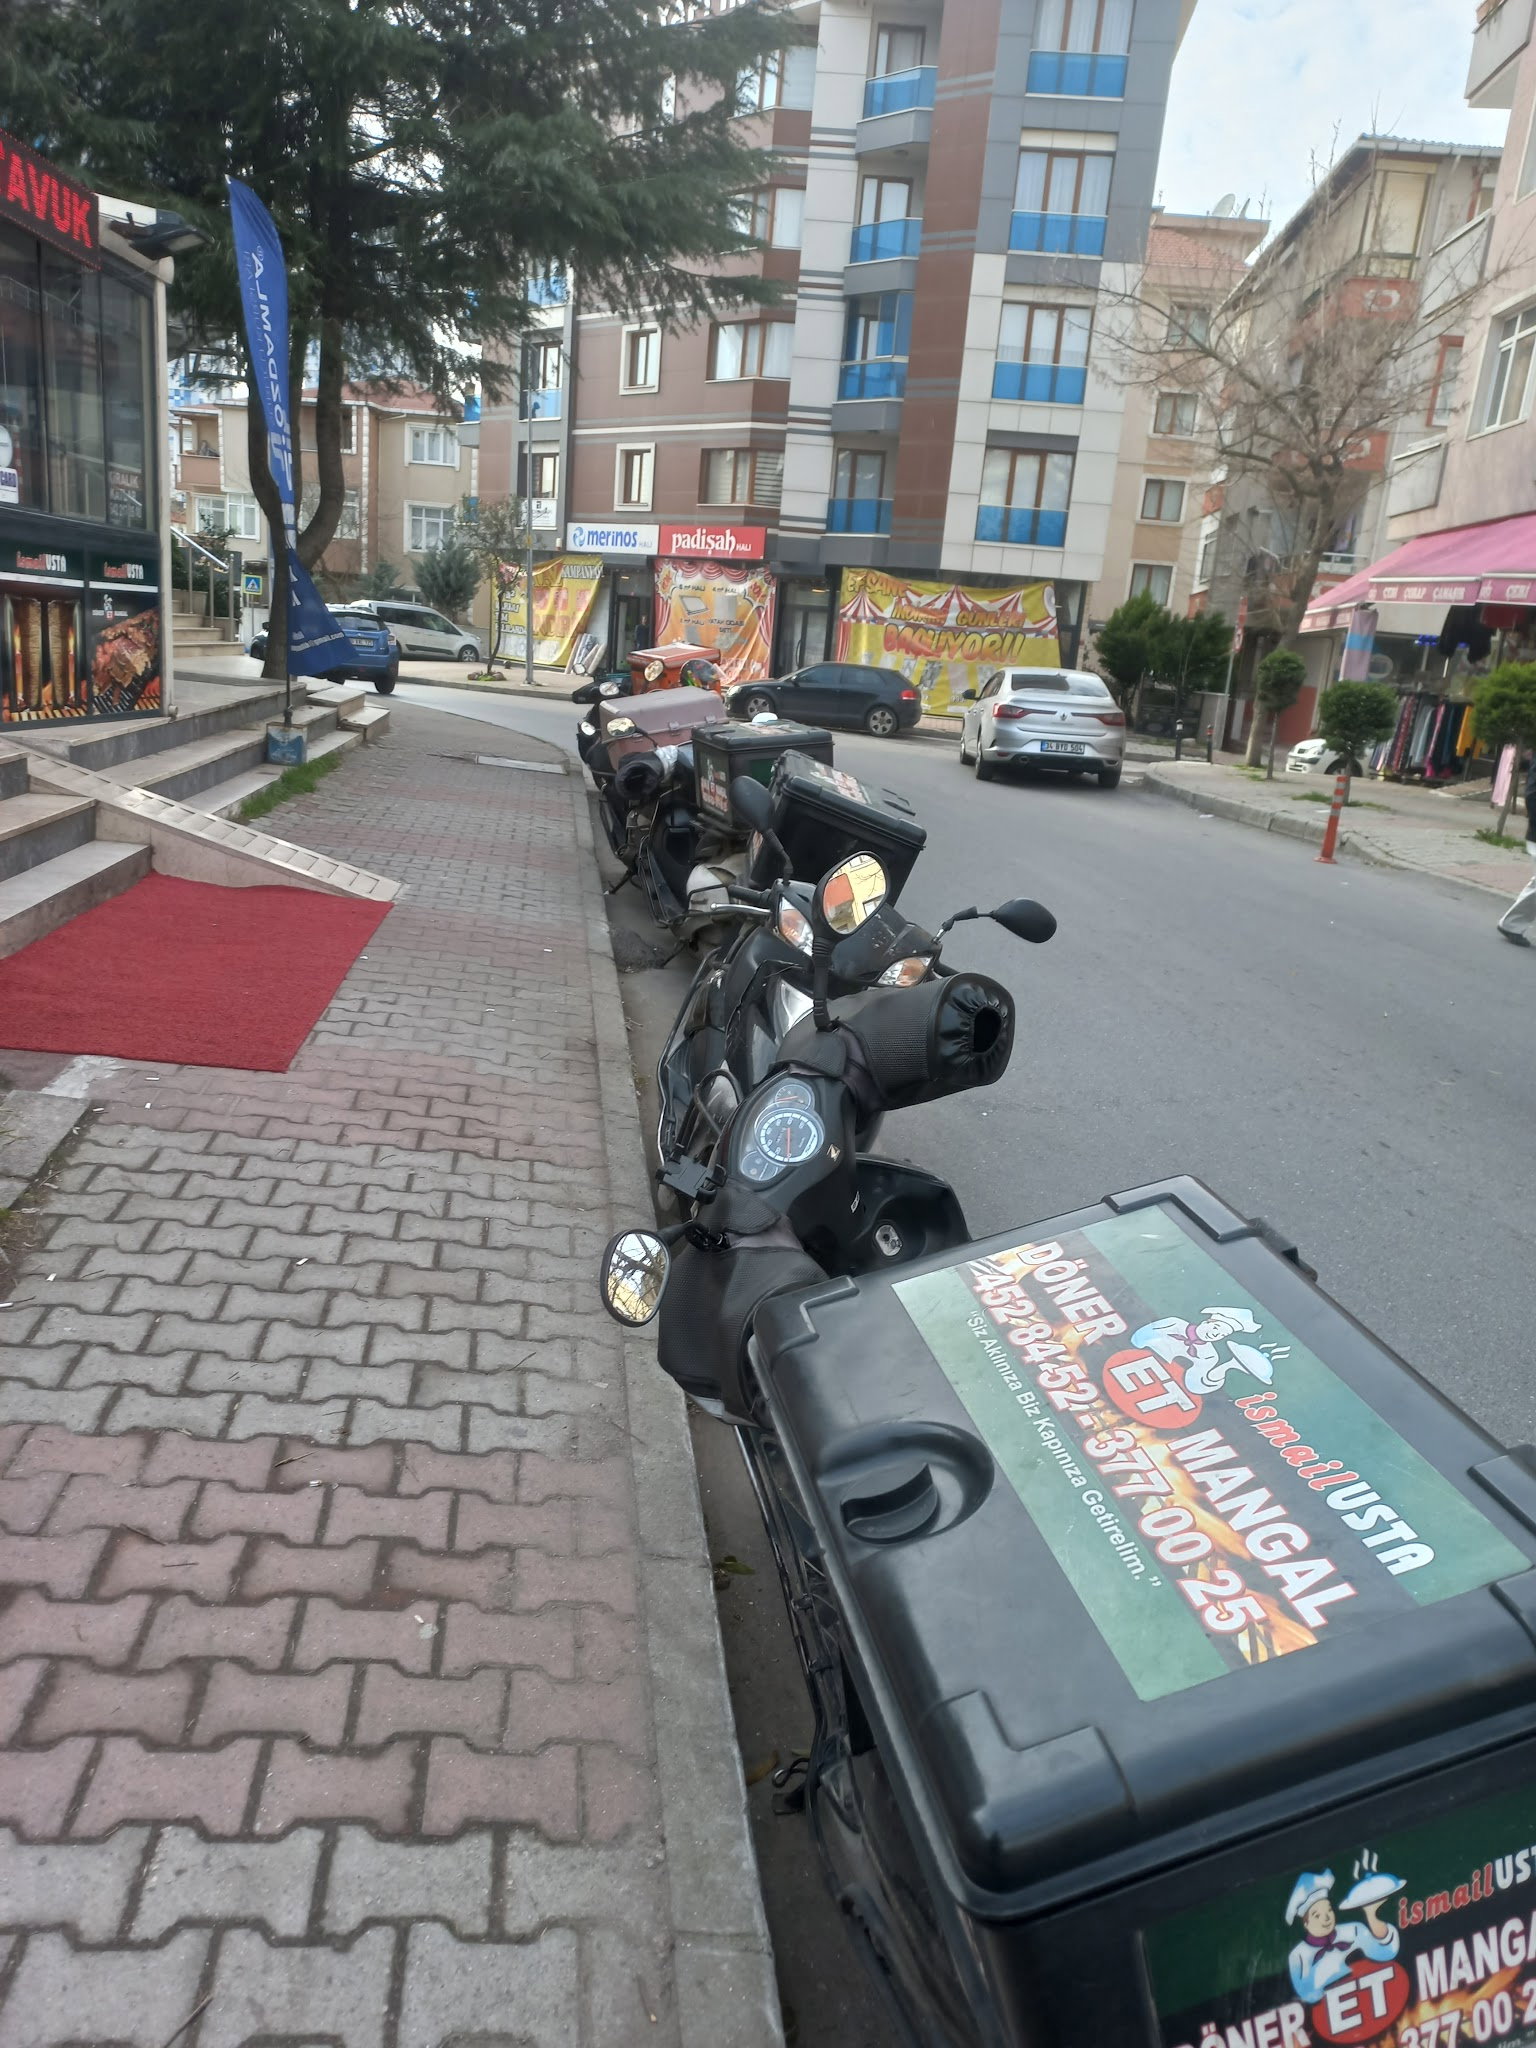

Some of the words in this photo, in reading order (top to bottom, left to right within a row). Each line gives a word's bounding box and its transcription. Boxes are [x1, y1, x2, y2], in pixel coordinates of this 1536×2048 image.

[0, 140, 92, 248] AVUK
[587, 529, 637, 548] merinos
[672, 528, 736, 554] padişah
[737, 543, 751, 551] HALI
[973, 1273, 1037, 1325] 452
[1016, 1241, 1128, 1346] DÖNER
[1008, 1322, 1068, 1363] 84
[980, 1339, 1023, 1391] Aklınıza
[1016, 1391, 1041, 1418] Biz
[1033, 1417, 1087, 1489] Kapınıza
[1038, 1363, 1099, 1411] 52
[1109, 1355, 1196, 1416] ET
[1084, 1429, 1175, 1497] 377
[1138, 1506, 1215, 1564] 00
[1166, 1428, 1358, 1628] MANGAL
[1176, 1569, 1268, 1634] 25
[1172, 2001, 1312, 2048] ÖNER
[1325, 1966, 1396, 2036] ET
[1472, 1991, 1513, 2043] 00
